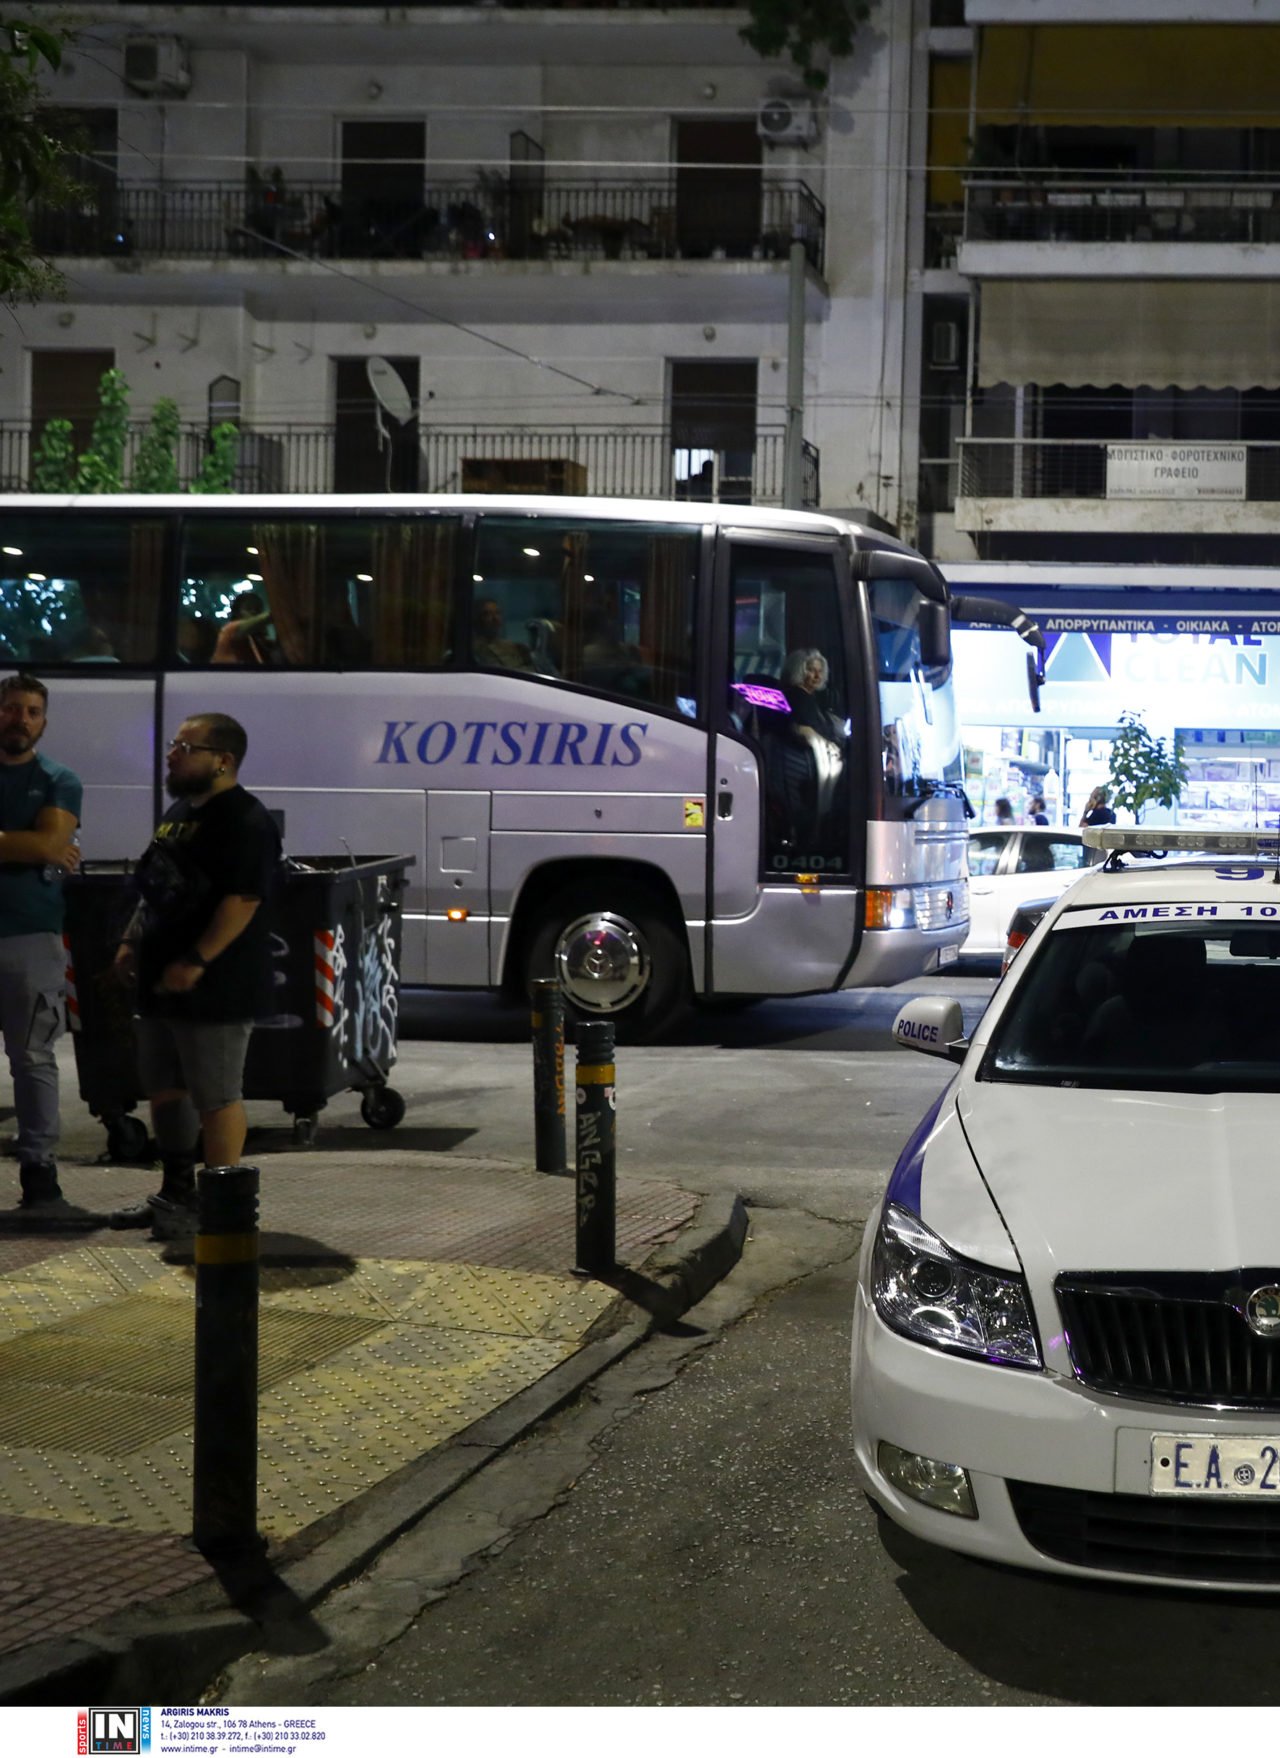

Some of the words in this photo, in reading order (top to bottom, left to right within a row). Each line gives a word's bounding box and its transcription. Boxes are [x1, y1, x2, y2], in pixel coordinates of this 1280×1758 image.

[1154, 467, 1199, 479] ΓΡΑΦΕΙΟ
[1046, 619, 1155, 632] ΑΠΟΡΡΥΠΑΝΤΙΚΑ
[1176, 620, 1230, 632] ΟΙΚΙΑΚΑ
[374, 721, 649, 767] KOTSIRIS
[1098, 905, 1218, 921] ΑΜΕΣΗ
[897, 1019, 939, 1043] POLICE
